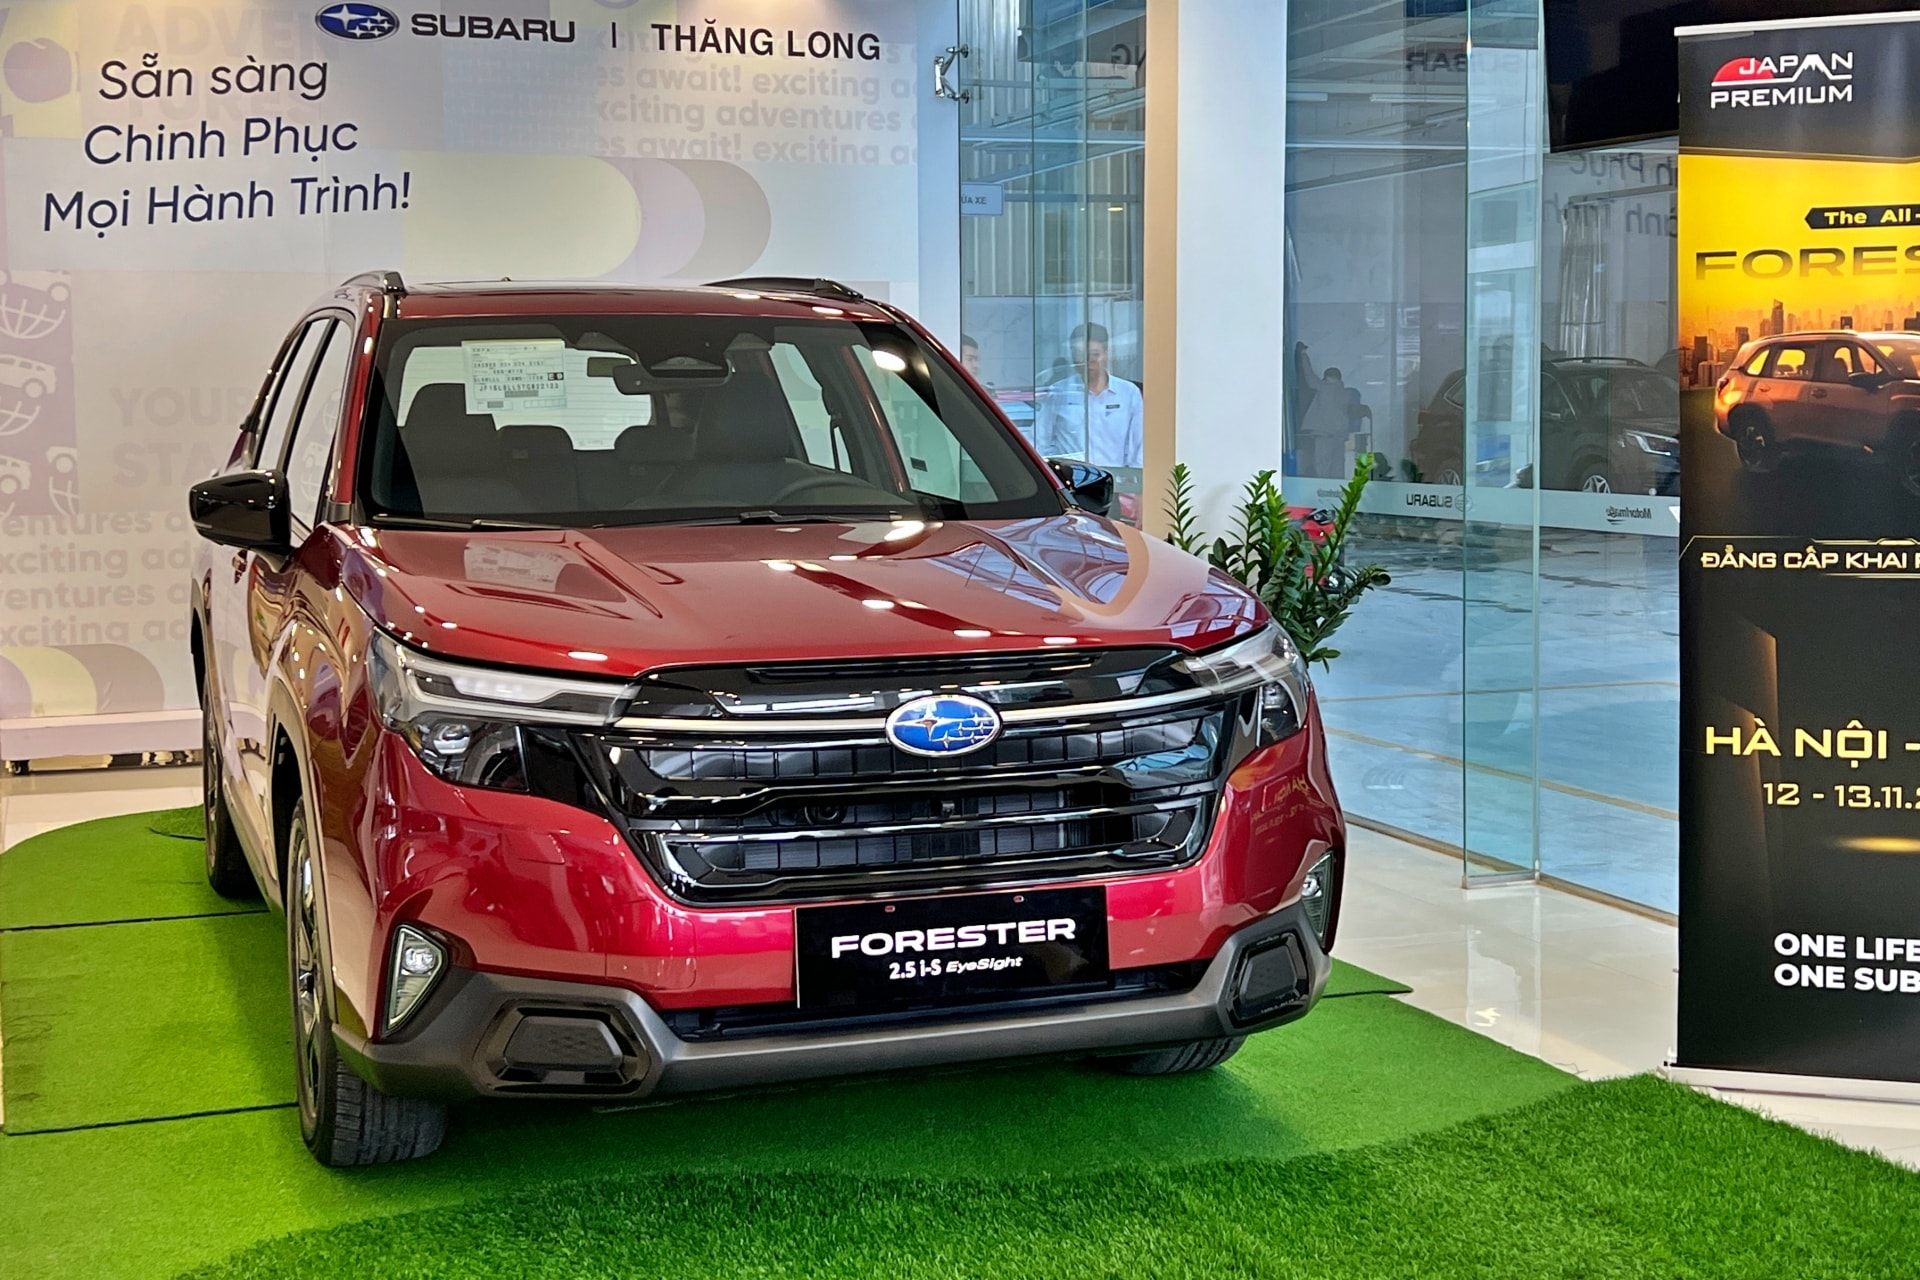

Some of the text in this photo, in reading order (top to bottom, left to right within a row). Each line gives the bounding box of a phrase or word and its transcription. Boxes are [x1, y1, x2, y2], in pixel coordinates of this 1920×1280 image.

[411, 13, 576, 43] SUBARU
[651, 18, 774, 56] THĂNG
[787, 30, 881, 60] LONG
[99, 52, 328, 101] Sẵn sàng
[1739, 52, 1854, 77] JAPAN
[636, 65, 742, 93] await!
[753, 69, 880, 104] exciting
[1710, 84, 1853, 110] PREMIUM
[716, 100, 901, 131] adventures
[84, 117, 358, 165] Chinh Phục
[44, 172, 411, 239] Mọi Hành Trình!
[1824, 210, 1867, 225] The
[1846, 552, 1907, 569] KHAI
[0, 582, 156, 610] entures
[1705, 717, 1781, 756] HÀ
[1795, 719, 1888, 768] NỘI
[1763, 783, 1800, 806] 12
[1834, 785, 1920, 809] 13.11.
[831, 918, 1076, 958] FORESTER
[1774, 933, 1920, 962] ONE LIFE
[889, 962, 916, 979] 2.5
[945, 956, 1023, 974] EyeSight
[1774, 963, 1920, 993] ONE SUB
